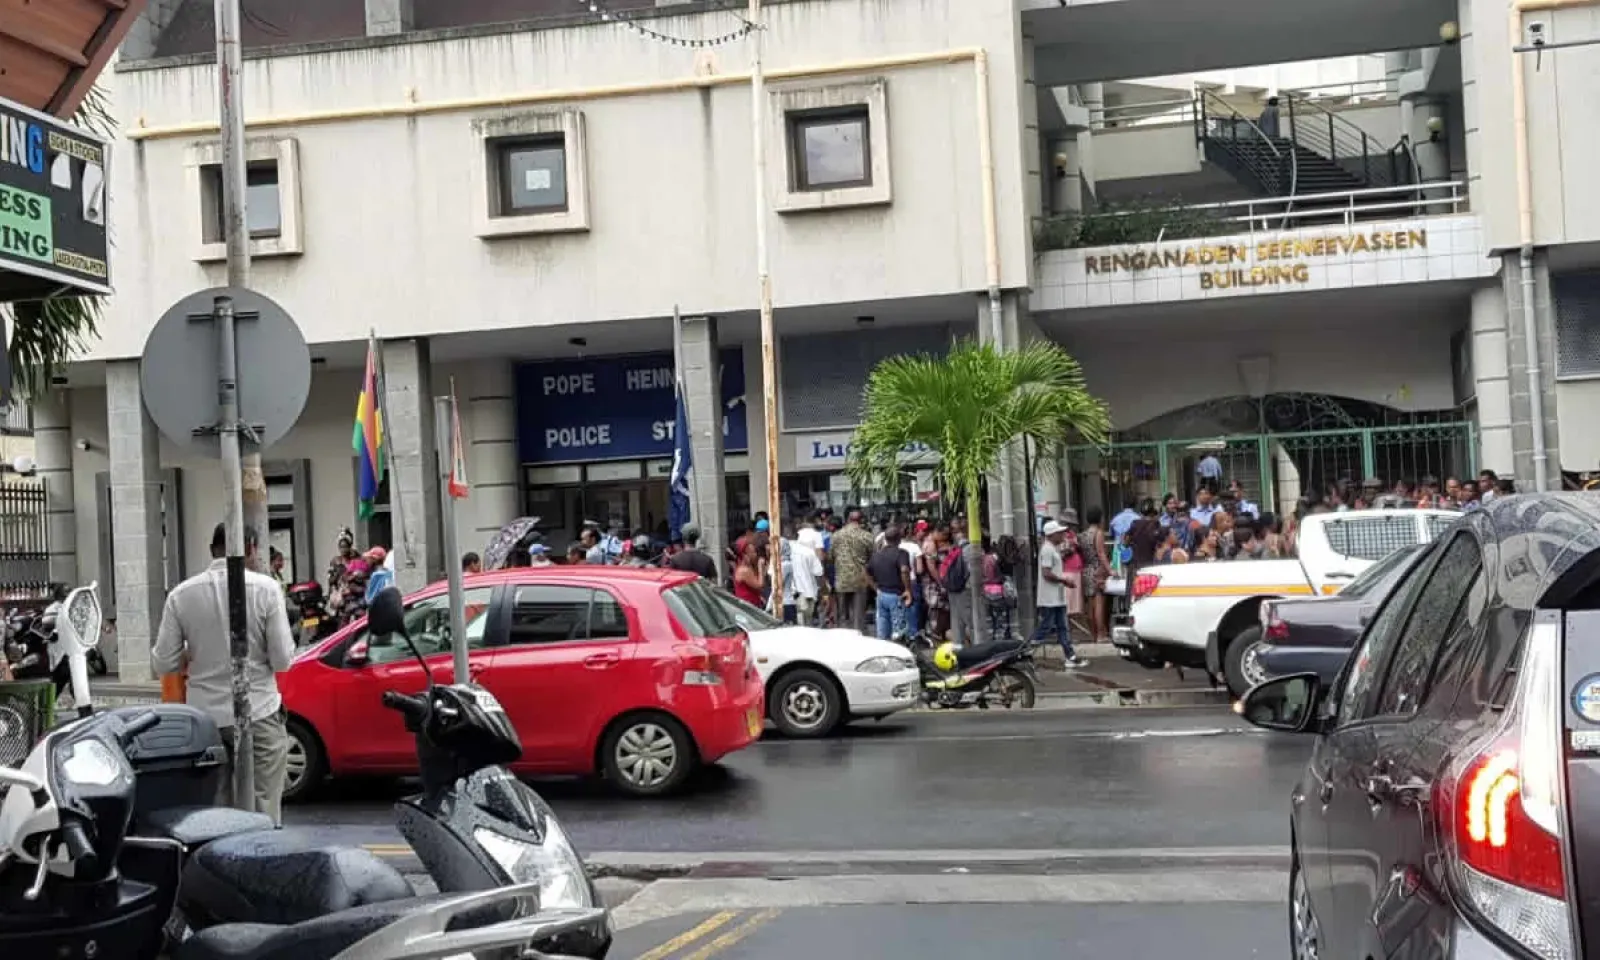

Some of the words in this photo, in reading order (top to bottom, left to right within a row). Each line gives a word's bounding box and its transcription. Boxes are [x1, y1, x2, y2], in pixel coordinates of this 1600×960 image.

[0, 225, 49, 257] ING
[1085, 244, 1246, 276] RENGANADEN
[1257, 229, 1427, 261] SEENEEVASSEN
[1200, 263, 1309, 289] BUILDING
[543, 373, 595, 395] POPE
[545, 424, 611, 448] POLICE
